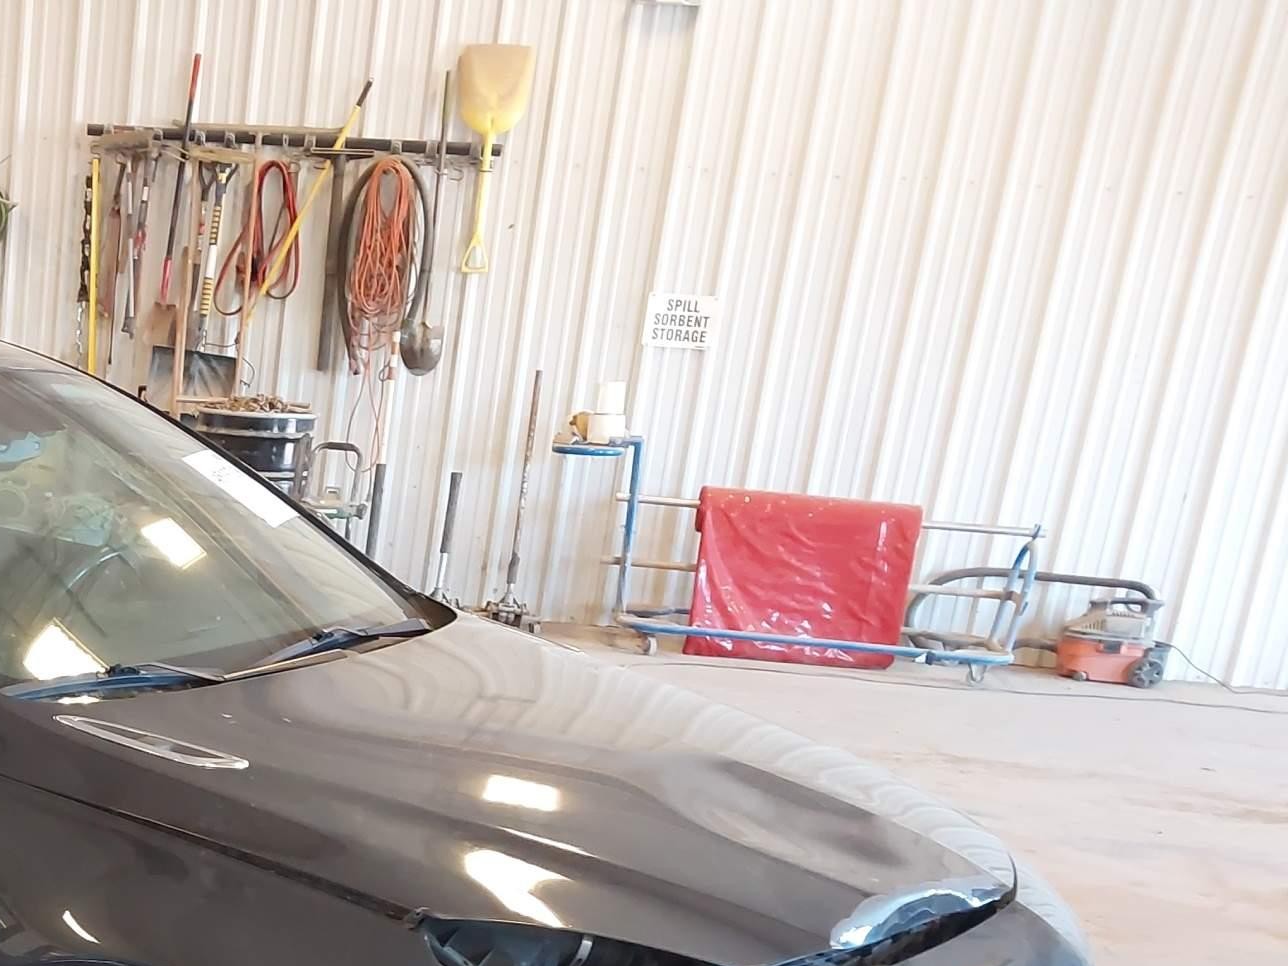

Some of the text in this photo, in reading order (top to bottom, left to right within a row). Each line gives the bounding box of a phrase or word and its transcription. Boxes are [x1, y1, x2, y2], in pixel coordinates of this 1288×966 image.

[666, 298, 700, 313] SPILL
[653, 312, 711, 328] SORBENT
[652, 327, 708, 343] STORAGE
